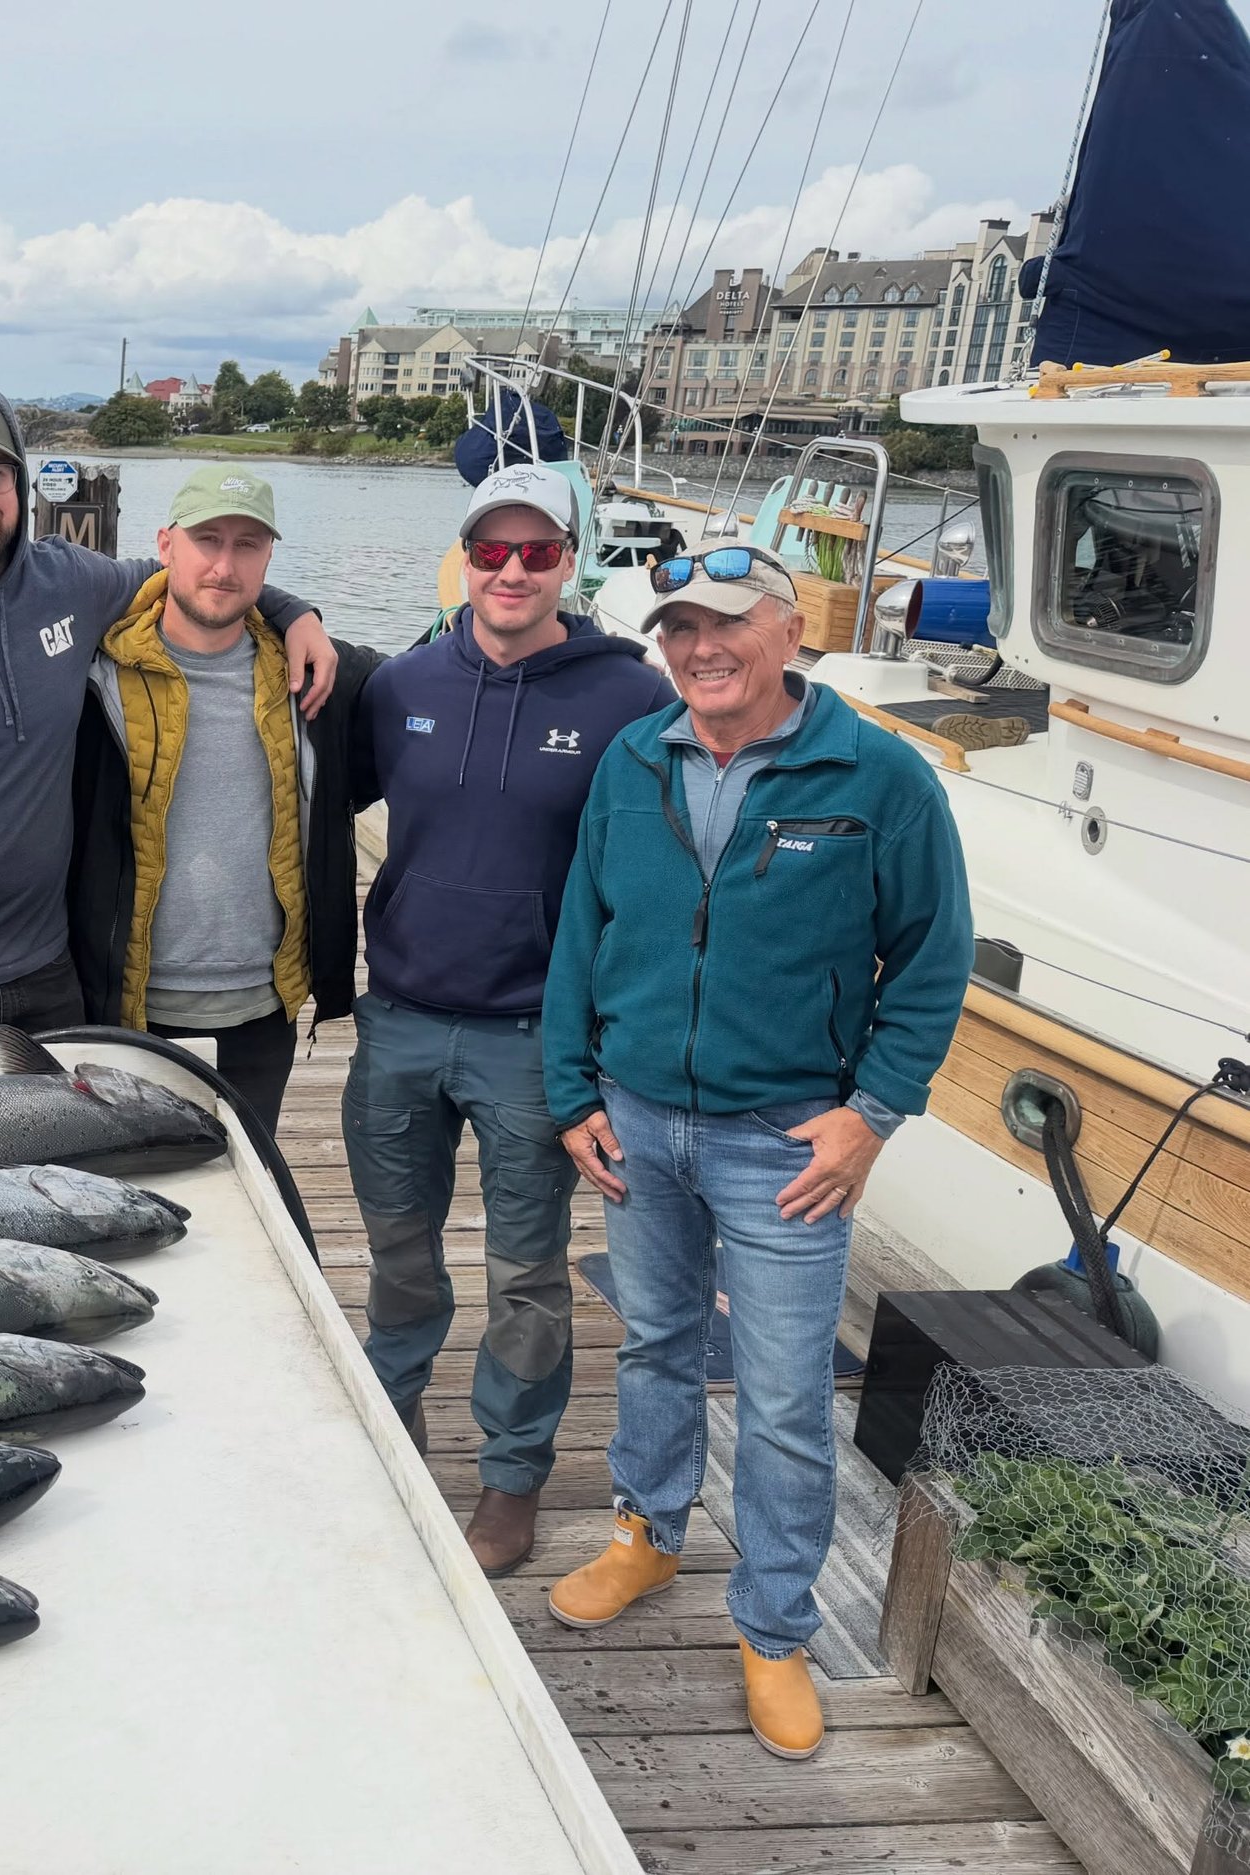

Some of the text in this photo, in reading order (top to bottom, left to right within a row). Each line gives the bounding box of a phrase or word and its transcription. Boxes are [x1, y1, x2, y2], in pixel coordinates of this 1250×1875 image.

[716, 291, 750, 300] DELTA
[60, 512, 95, 550] M
[40, 616, 74, 657] CAT
[776, 838, 814, 851] TAIGA
